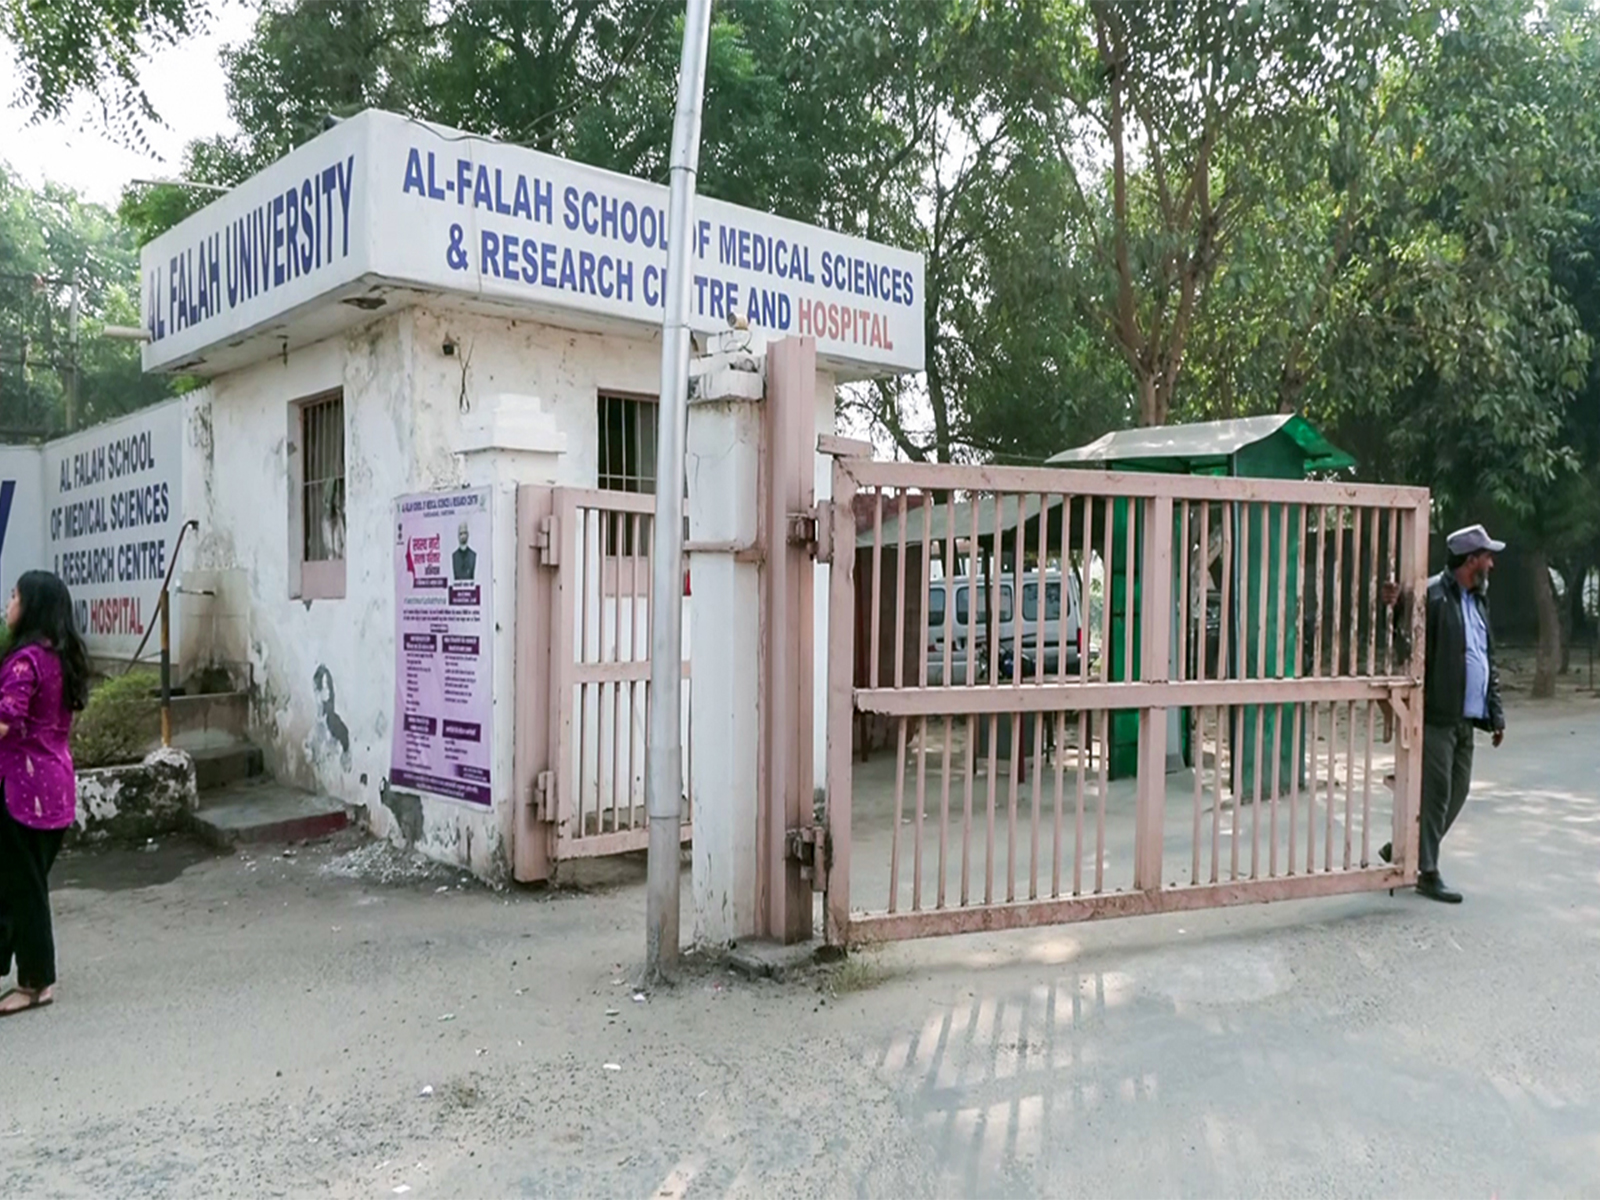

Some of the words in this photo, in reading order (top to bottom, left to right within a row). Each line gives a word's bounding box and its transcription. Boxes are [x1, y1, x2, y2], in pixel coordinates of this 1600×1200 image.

[170, 232, 220, 335] FALAH
[226, 154, 354, 309] UNIVERSITY
[403, 147, 553, 225] AL-FALAH
[563, 186, 668, 251] SCHOOL
[692, 219, 711, 260] F
[719, 225, 815, 284] MEDICAL
[821, 250, 915, 307] SCIENCES
[446, 223, 469, 271] &
[481, 230, 633, 302] RESEARCH
[643, 264, 738, 320] CTRE
[746, 286, 791, 331] AND
[799, 297, 893, 350] HOSPITAL
[60, 458, 72, 493] AL
[74, 446, 105, 489] FALAH
[108, 431, 154, 480] SCHOOL
[51, 507, 62, 541] OF
[65, 497, 107, 539] MEDICAL
[111, 482, 169, 531] SCIENCES
[63, 546, 114, 586] RESEARCH
[118, 540, 165, 582] CENTRE
[91, 596, 144, 635] HOSPITAL
